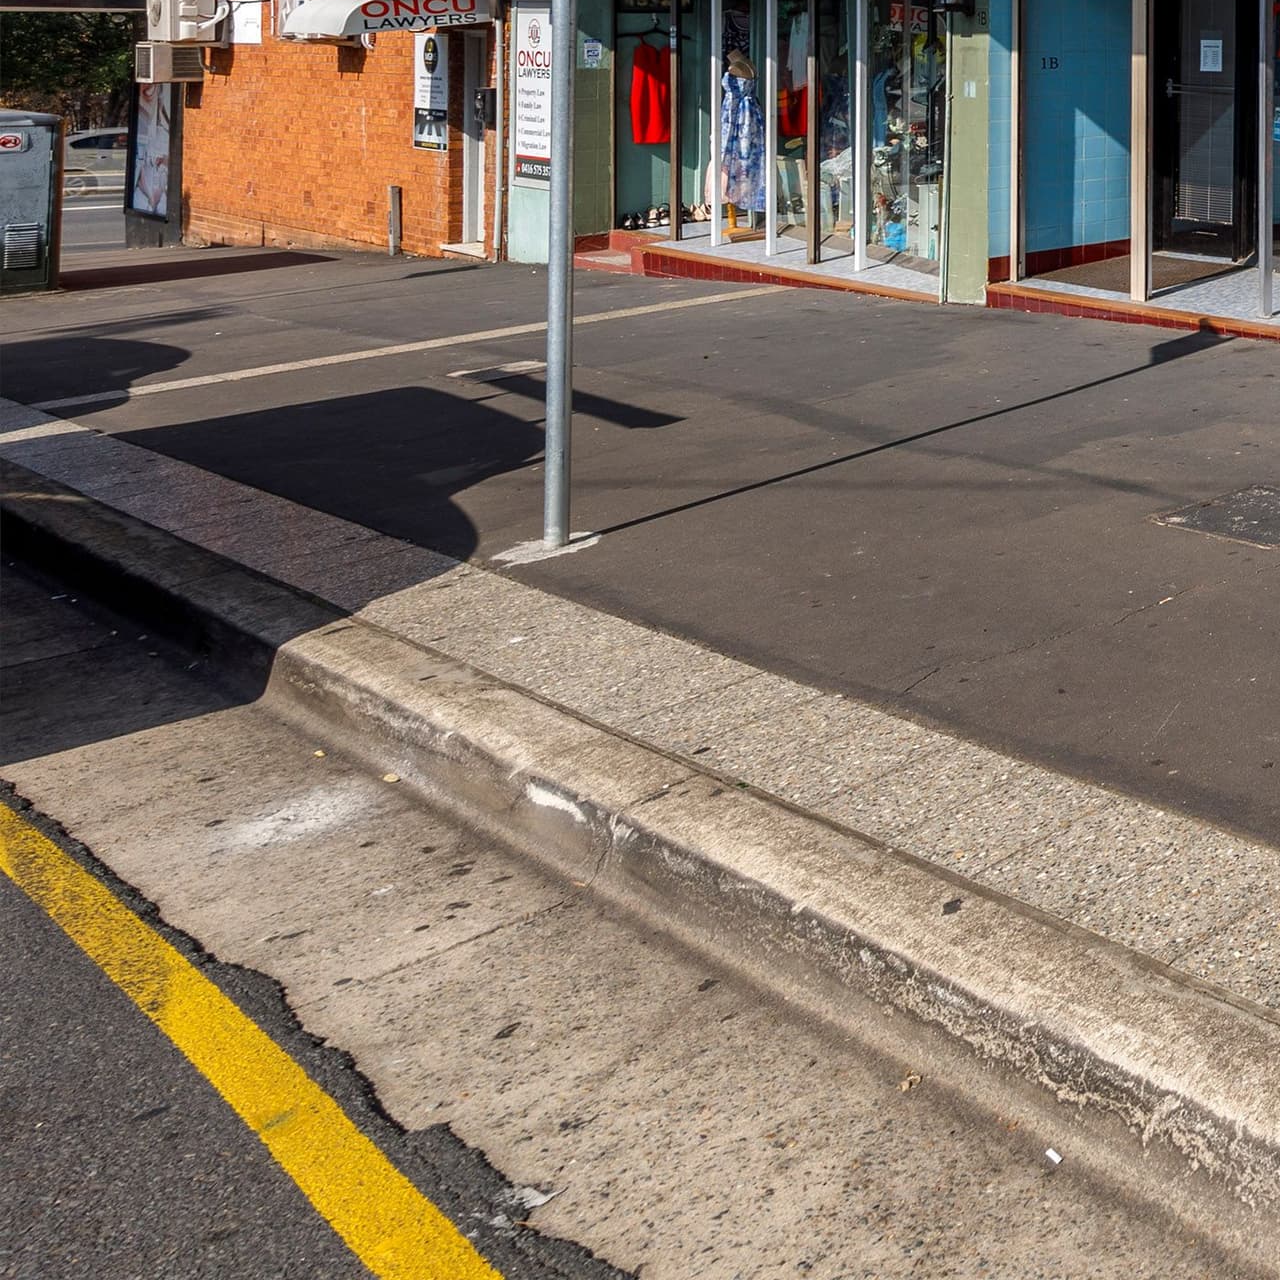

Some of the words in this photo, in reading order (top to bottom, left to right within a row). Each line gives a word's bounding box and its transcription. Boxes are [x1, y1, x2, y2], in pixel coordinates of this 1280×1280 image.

[363, 13, 477, 29] LAWYERS
[518, 51, 551, 68] ONCU
[1041, 57, 1059, 69] 1B
[518, 68, 551, 79] LAWYERS
